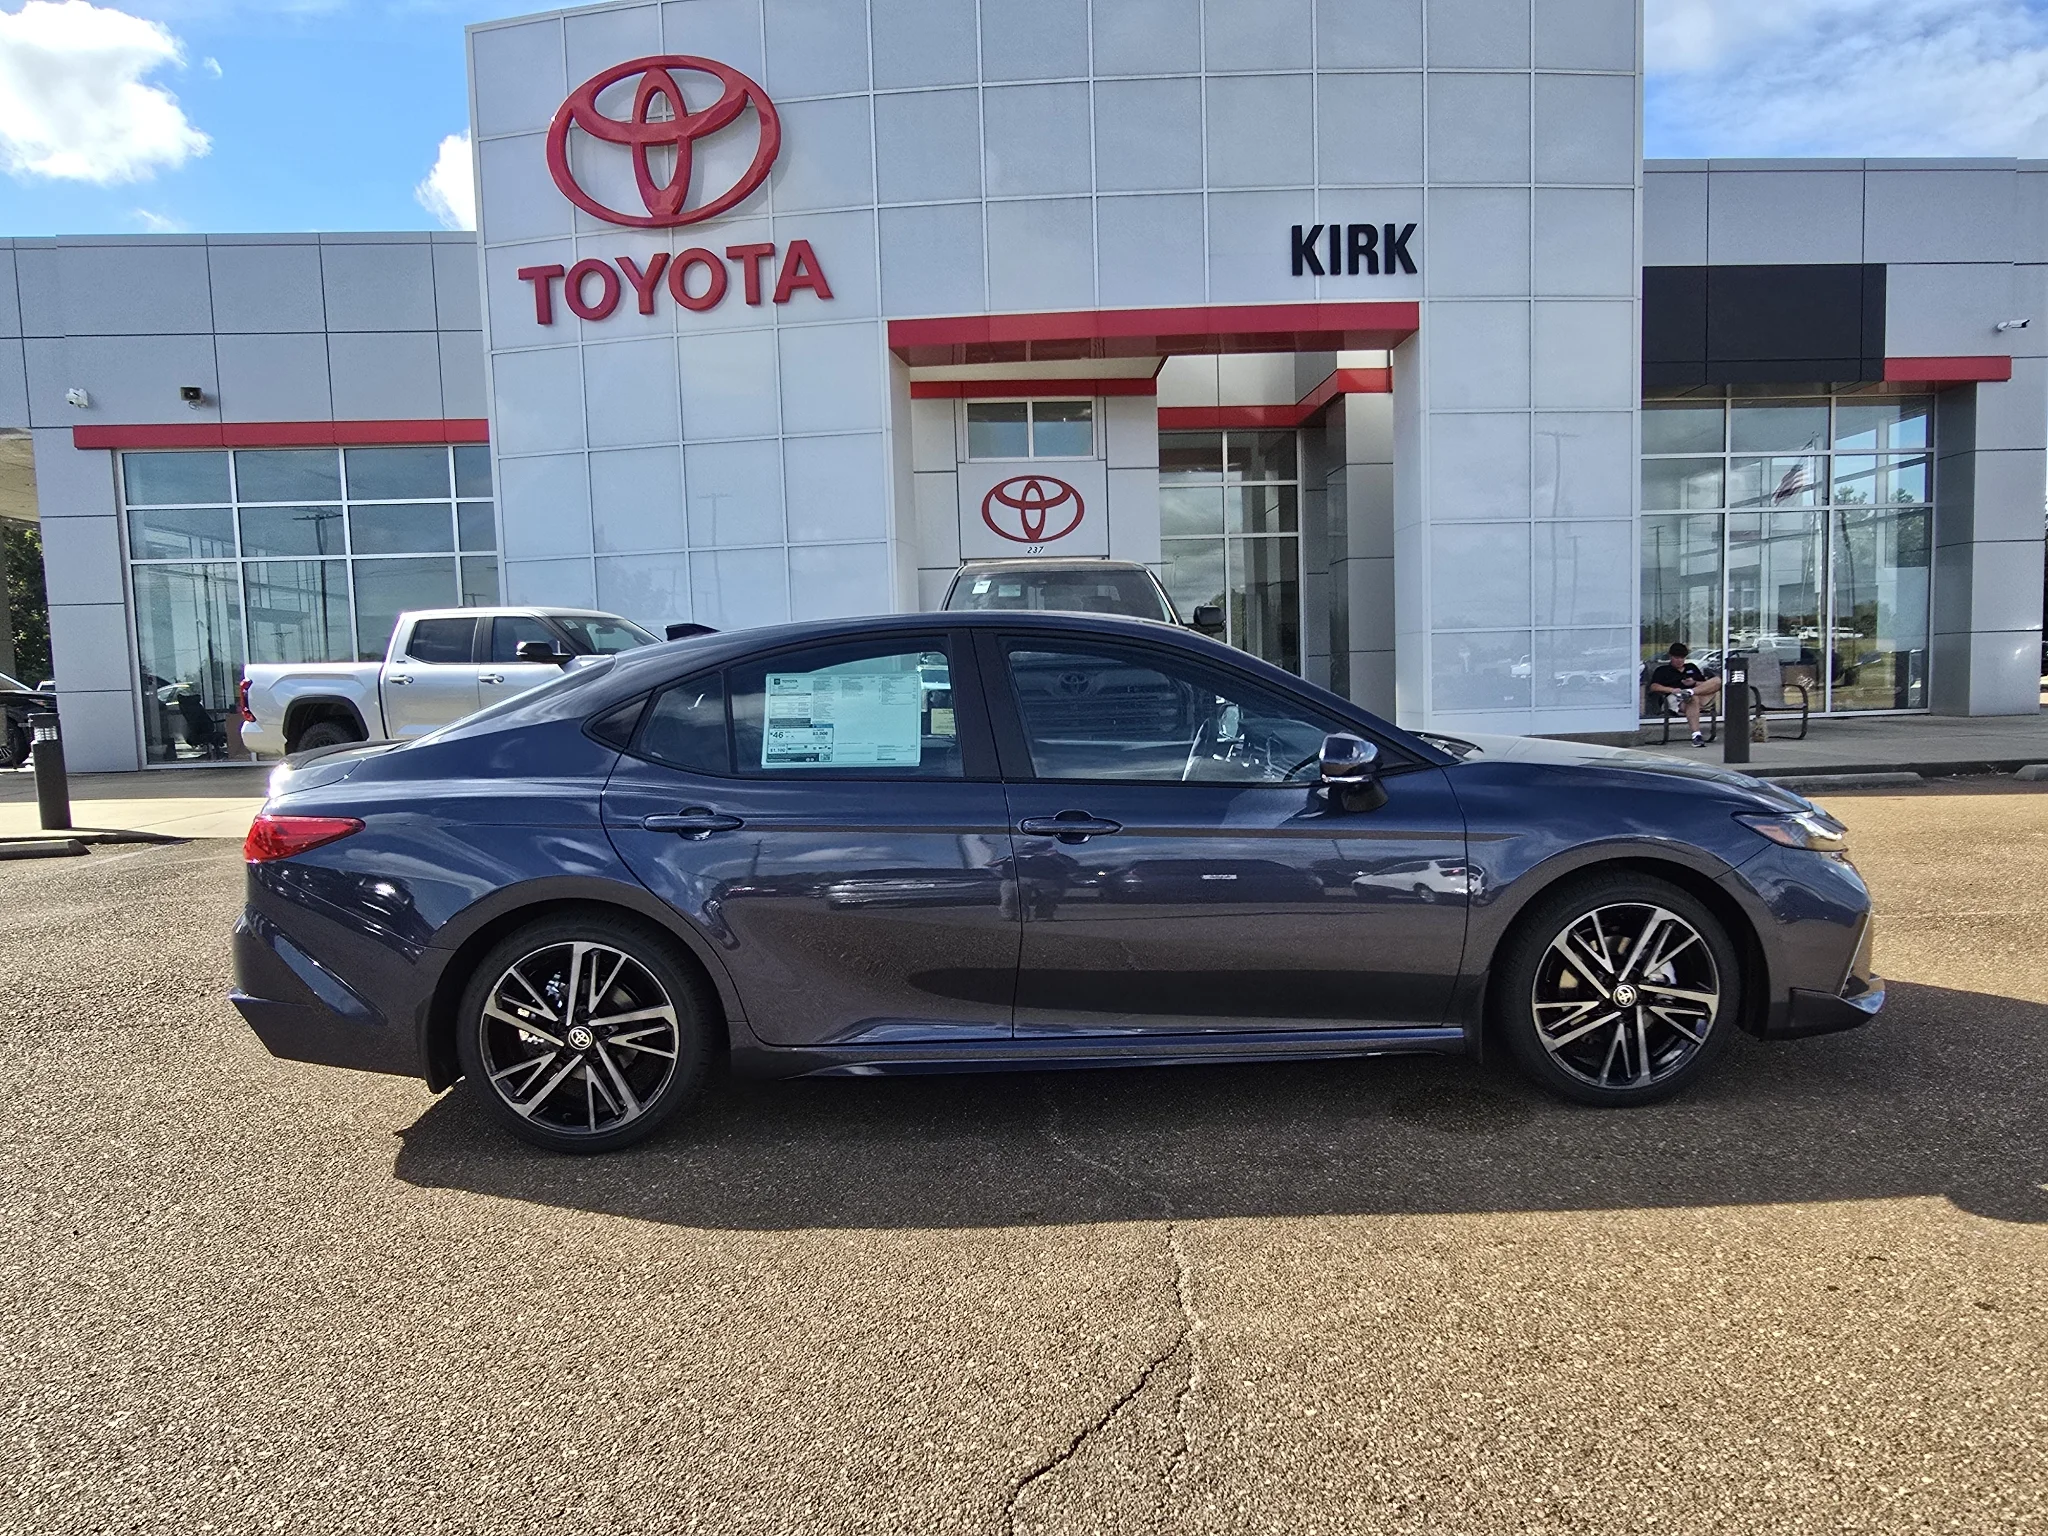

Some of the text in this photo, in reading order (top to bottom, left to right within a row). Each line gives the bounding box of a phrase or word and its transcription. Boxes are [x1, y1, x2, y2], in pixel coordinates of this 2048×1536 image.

[1291, 223, 1418, 276] KIRK
[518, 239, 834, 325] TOYOTA
[1027, 546, 1044, 554] 237
[773, 731, 784, 739] 46
